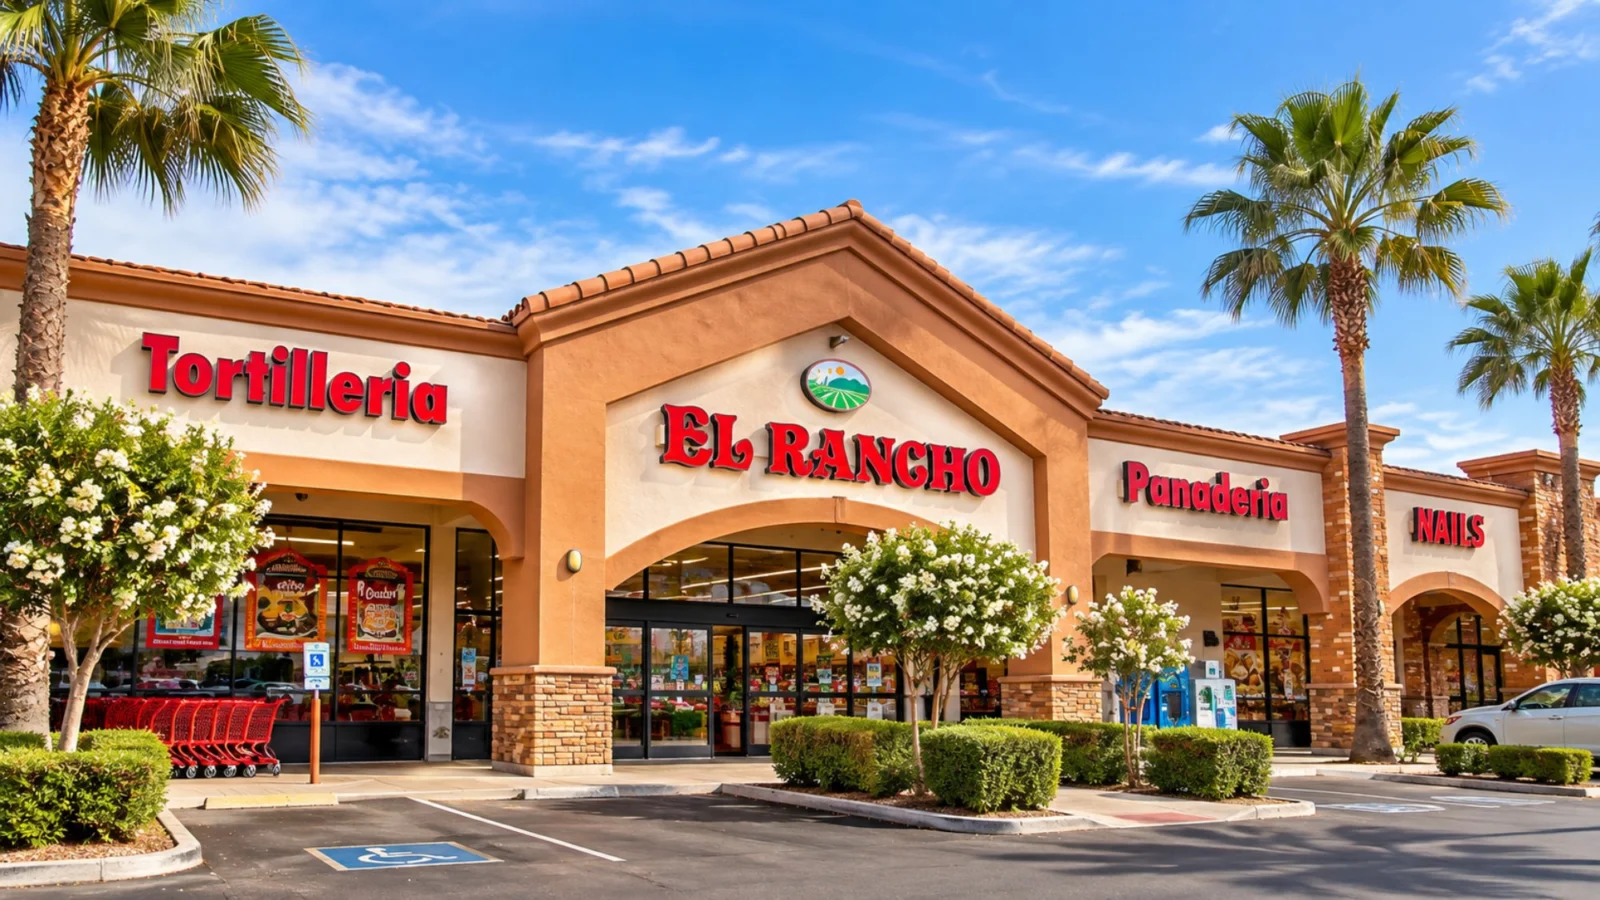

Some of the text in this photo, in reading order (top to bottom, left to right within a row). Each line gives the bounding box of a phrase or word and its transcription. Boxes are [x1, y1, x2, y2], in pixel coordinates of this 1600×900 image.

[141, 332, 447, 424] Tortilleria
[660, 403, 1001, 496] EL RANCHO
[1123, 461, 1288, 521] Panaderia
[1413, 506, 1485, 548] NAILS
